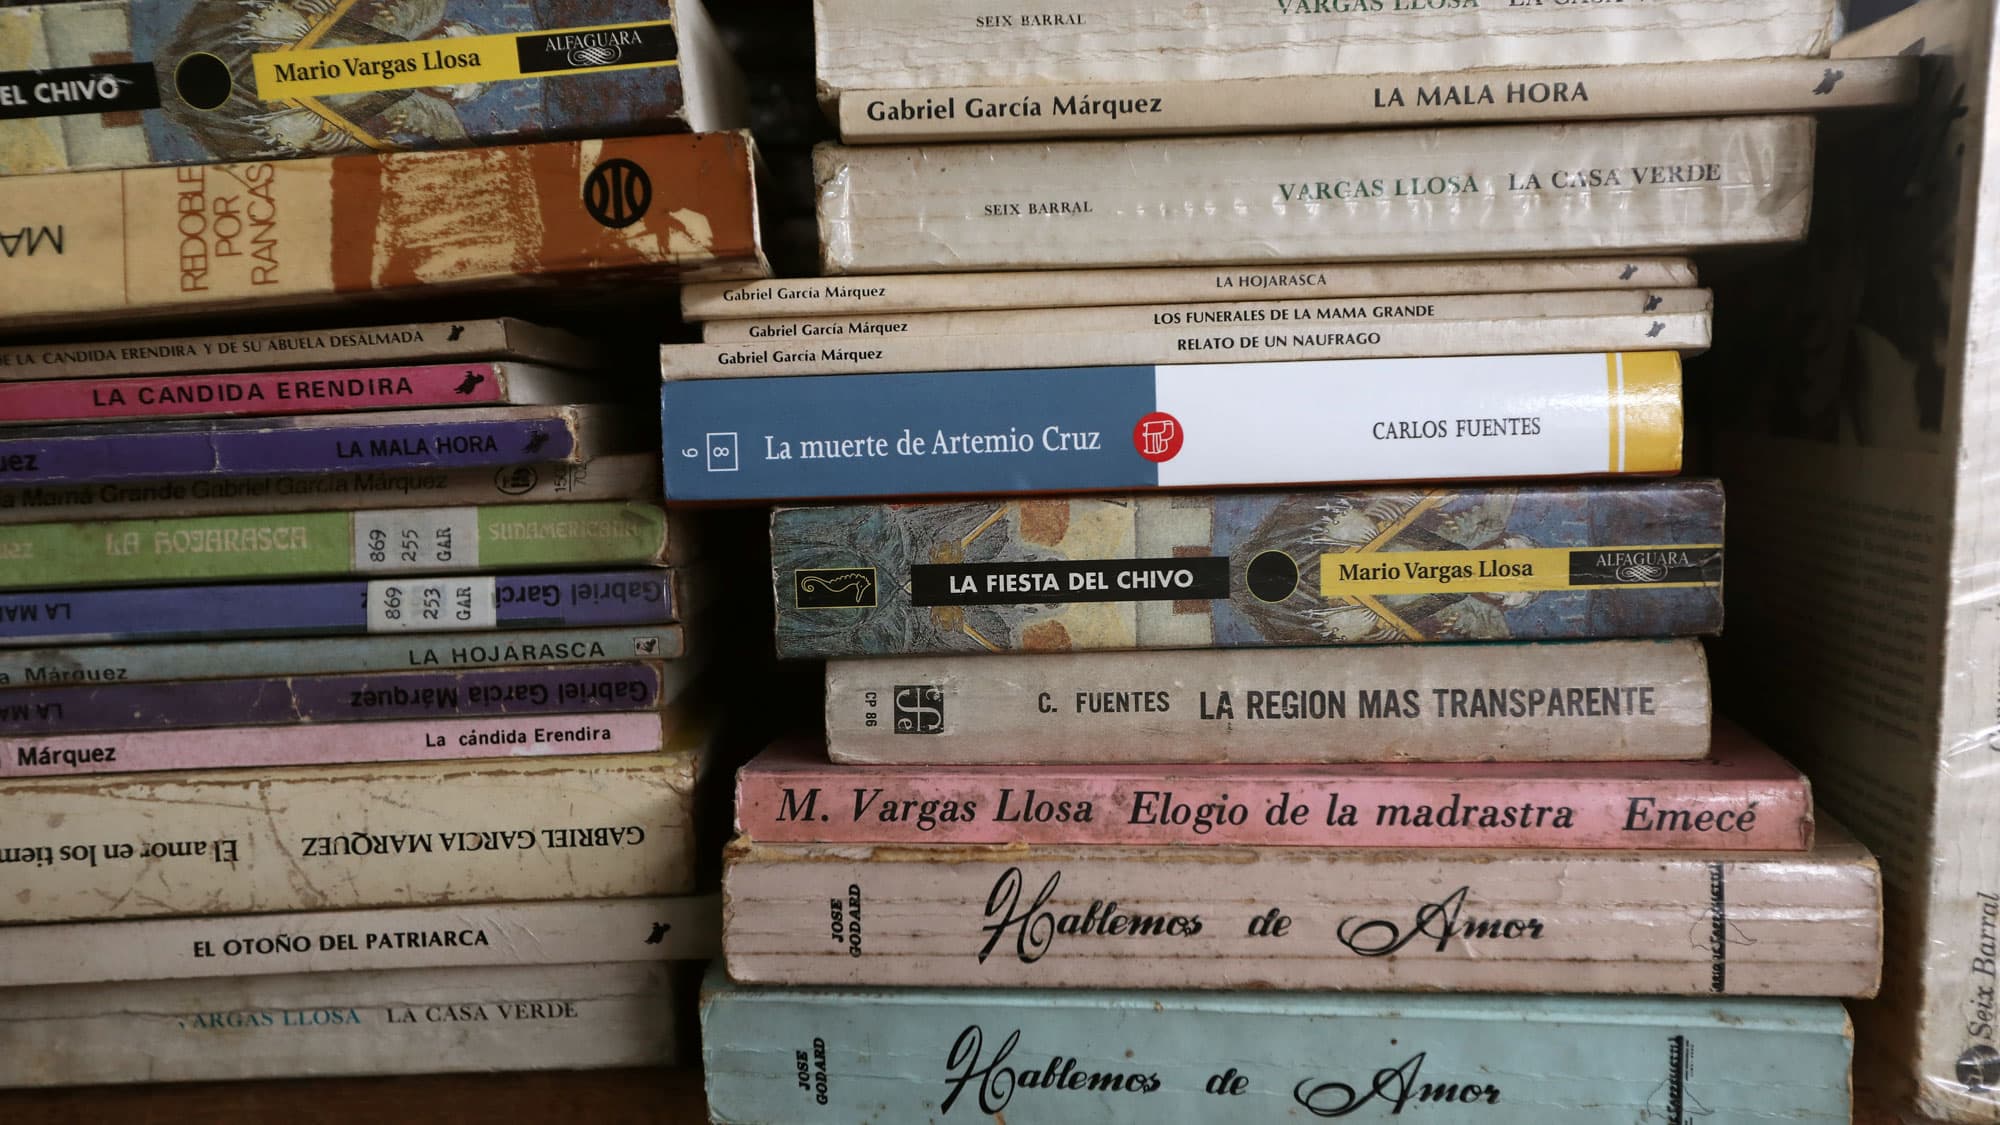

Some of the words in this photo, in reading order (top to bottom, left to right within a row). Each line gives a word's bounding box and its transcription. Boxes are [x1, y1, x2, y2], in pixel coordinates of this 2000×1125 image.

[976, 14, 1013, 28] SEIX
[1021, 13, 1086, 26] BARRAL
[544, 29, 643, 53] ALFAGUARA
[275, 59, 343, 84] Mario
[345, 53, 417, 82] Vargas
[423, 48, 482, 72] Llosa
[0, 86, 28, 106] EL
[34, 76, 119, 104] CHIVO
[1374, 88, 1404, 108] LA
[1417, 84, 1494, 106] MALA
[1508, 81, 1588, 103] HORA
[867, 97, 954, 121] Gabriel
[965, 95, 1042, 118] García
[1053, 92, 1162, 120] Márquez
[1279, 180, 1384, 201] VARGAS
[1394, 176, 1479, 196] LLOSA
[1508, 171, 1541, 191] LA
[1552, 168, 1622, 189] CASA
[1632, 163, 1721, 185] VERDE
[984, 203, 1020, 216] SEIX
[1027, 201, 1092, 215] BARRAL
[177, 166, 208, 292] REDOBLE
[213, 195, 243, 257] POR
[246, 163, 280, 285] RANCAS
[1216, 275, 1234, 288] LA
[1238, 272, 1327, 289] HOJARASCA
[723, 287, 772, 303] Gabriel
[777, 286, 819, 301] García
[825, 284, 886, 301] Márquez
[1154, 312, 1181, 325] LOS
[1186, 310, 1267, 324] FUNERALES
[1269, 309, 1287, 321] DE
[1294, 308, 1311, 320] LA
[1317, 306, 1367, 320] MAMA
[1372, 304, 1435, 318] GRANDE
[749, 324, 797, 338] Gabriel
[802, 322, 843, 337] García
[849, 320, 908, 337] Márquez
[16, 351, 35, 366] LA
[43, 349, 116, 365] CANDIDA
[122, 345, 196, 361] ERENDIRA
[204, 343, 213, 355] Y
[219, 341, 239, 354] DE
[244, 340, 262, 353] SU
[269, 335, 325, 352] ABUELA
[329, 329, 424, 349] DESALMADA
[1177, 337, 1234, 351] RELATO
[1239, 336, 1258, 349] DE
[1264, 336, 1286, 348] UN
[1293, 333, 1381, 348] NAUFRAGO
[718, 351, 767, 365] Gabriel
[773, 349, 816, 364] García
[821, 346, 883, 364] Márquez
[92, 388, 126, 406] LA
[138, 382, 264, 405] CANDIDA
[277, 376, 414, 400] ERENDIRA
[1373, 420, 1448, 441] CARLOS
[1455, 417, 1541, 439] FUENTES
[336, 440, 364, 459] LA
[370, 437, 430, 457] MALA
[436, 434, 497, 454] HORA
[713, 446, 729, 458] 8
[765, 435, 792, 460] La
[799, 436, 888, 459] muerte
[897, 429, 926, 456] de
[931, 427, 1034, 454] Artemio
[1042, 425, 1101, 452] Cruz
[100, 481, 186, 504] Grande
[192, 476, 269, 500] Gabriel
[105, 532, 140, 555] LA
[370, 529, 386, 561] 869
[402, 528, 418, 560] 255
[436, 527, 452, 561] GAR
[1338, 560, 1400, 582] Mario
[1404, 561, 1473, 583] Vargas
[1478, 558, 1533, 579] Llosa
[1596, 550, 1690, 569] ALFAGUARA
[571, 581, 663, 603] Gabriel
[950, 574, 978, 594] LA
[986, 571, 1060, 593] FIESTA
[1070, 570, 1108, 591] DEL
[1116, 568, 1194, 589] CHIVO
[45, 602, 71, 621] LA
[385, 586, 401, 620] 869
[424, 587, 439, 620] 253
[456, 586, 472, 620] GAR
[409, 647, 439, 665] LA
[452, 640, 605, 665] HOJARASCA
[350, 687, 457, 711] Márquez
[471, 683, 548, 705] García
[558, 680, 648, 703] Gabriel
[865, 692, 876, 707] CP
[1038, 693, 1058, 713] C.
[1077, 691, 1170, 713] FUENTES
[1201, 690, 1233, 721] LA
[1248, 690, 1345, 720] REGION
[1359, 689, 1420, 719] MAS
[1431, 687, 1654, 718] TRANSPARENTE
[37, 704, 62, 720] LA
[865, 712, 877, 727] 86
[426, 732, 446, 747] La
[459, 726, 527, 745] cándida
[534, 725, 611, 742] Erendira
[17, 744, 117, 768] Márquez
[776, 788, 830, 822] M.
[852, 788, 976, 831] Vargas
[993, 787, 1094, 823] Llosa
[1128, 790, 1248, 834] Elogio
[1266, 792, 1309, 826] de
[1327, 792, 1358, 827] la
[1376, 792, 1574, 829] madrastra
[1622, 796, 1756, 832] Emecé
[140, 841, 207, 858] amor
[302, 832, 432, 857] MARQUEZ
[439, 829, 536, 852] GARCIA
[541, 826, 645, 848] GABRIEL
[60, 845, 97, 867] los
[103, 844, 134, 858] en
[214, 839, 239, 862] El
[831, 898, 843, 942] JOSE
[849, 883, 861, 957] GODARD
[978, 867, 1203, 963] Hablemos
[1248, 908, 1292, 937] de
[1338, 886, 1544, 956] Amor
[193, 940, 216, 958] EL
[222, 930, 311, 956] OTOÑO
[319, 932, 358, 952] DEL
[366, 928, 488, 951] PATRIARCA
[1971, 891, 1999, 976] Barral
[178, 1008, 273, 1030] ARGAS
[283, 1008, 360, 1027] LLOSA
[387, 1007, 417, 1024] LA
[426, 1006, 487, 1023] CASA
[497, 1003, 578, 1021] VERDE
[1967, 986, 1995, 1040] Seix
[798, 1050, 809, 1090] JOSE
[816, 1037, 826, 1104] GODARD
[941, 1025, 1161, 1115] Hablemos
[1206, 1068, 1249, 1095] de
[1294, 1052, 1500, 1118] Amor
